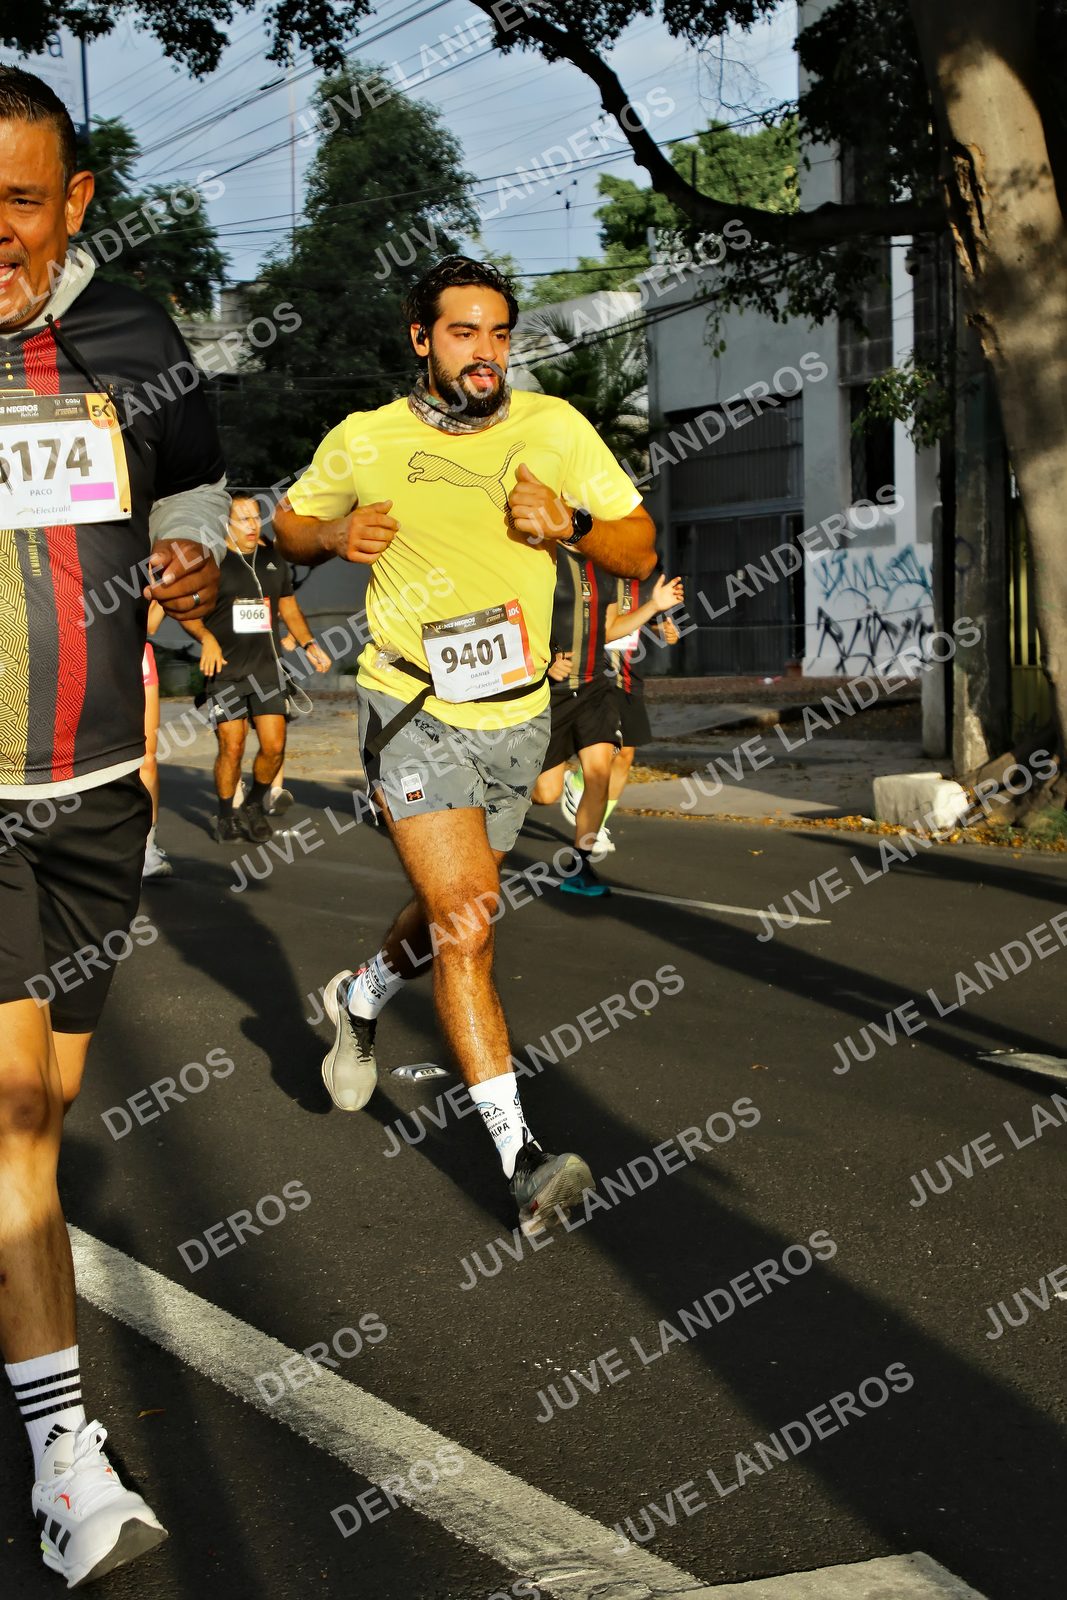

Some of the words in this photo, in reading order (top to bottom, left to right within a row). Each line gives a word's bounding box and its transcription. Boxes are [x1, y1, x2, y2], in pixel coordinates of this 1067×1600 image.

[6, 404, 38, 414] NEGROS
[30, 488, 53, 497] PACO
[239, 608, 265, 620] 9066
[440, 633, 508, 674] 9401
